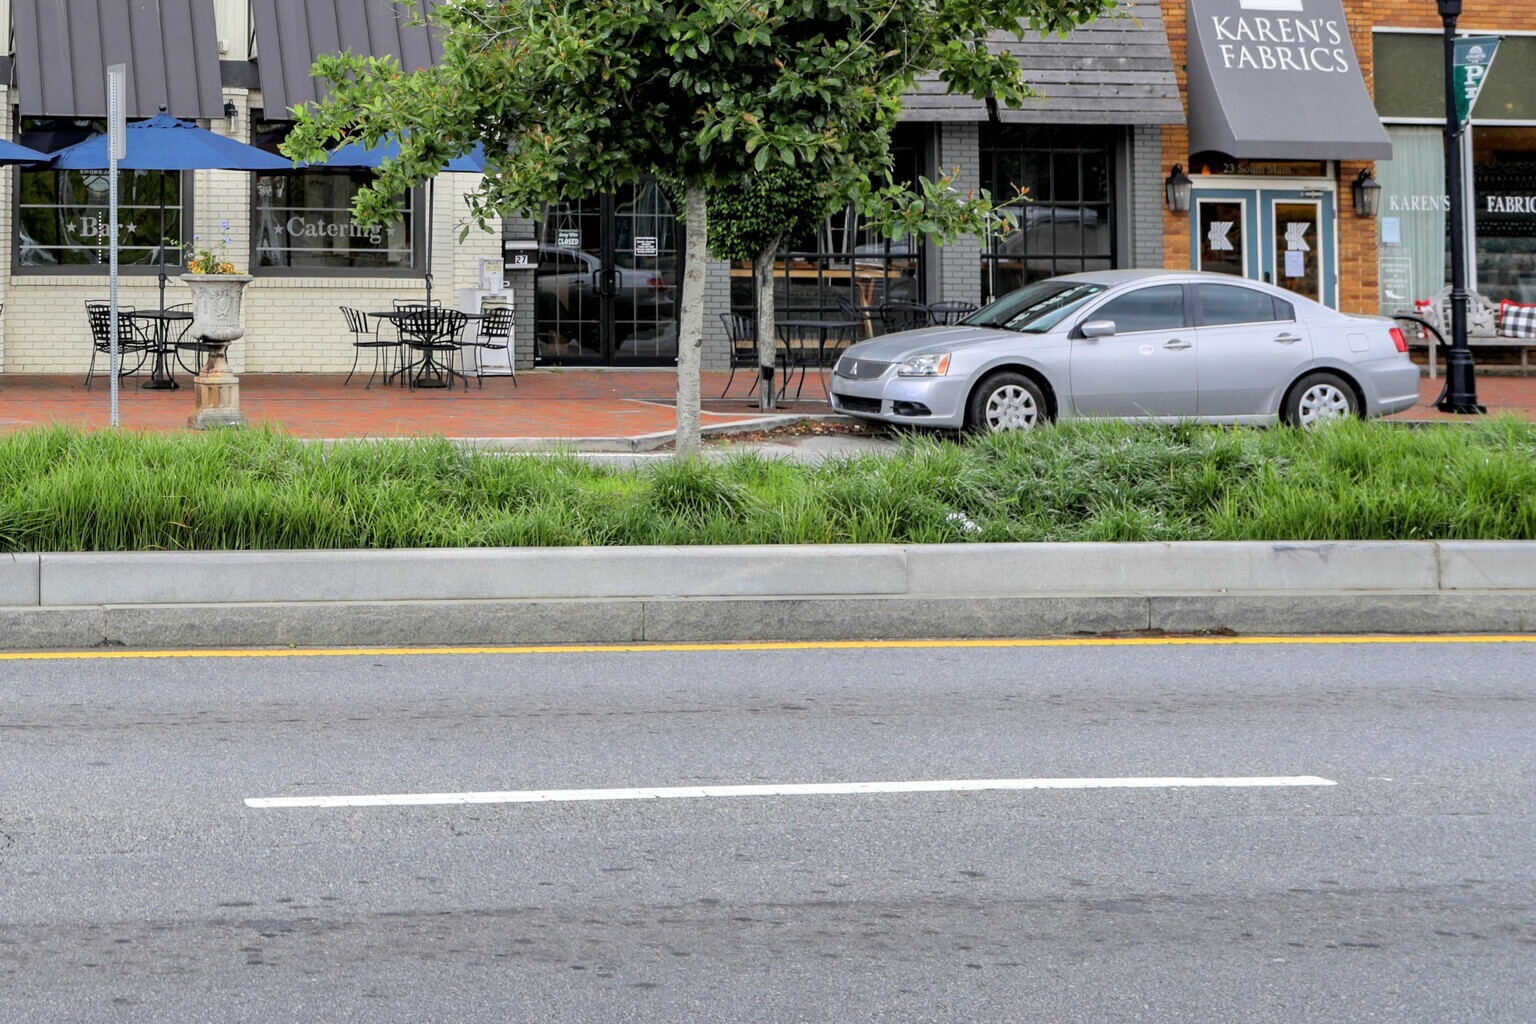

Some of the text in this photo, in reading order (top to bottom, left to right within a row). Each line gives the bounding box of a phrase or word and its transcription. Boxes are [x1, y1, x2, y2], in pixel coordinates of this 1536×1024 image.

[1211, 16, 1341, 45] KAREN'S
[1218, 44, 1349, 73] FABRICS
[1223, 163, 1292, 174] 23 South Main
[1389, 195, 1451, 211] KAREN'S
[516, 256, 527, 264] 27
